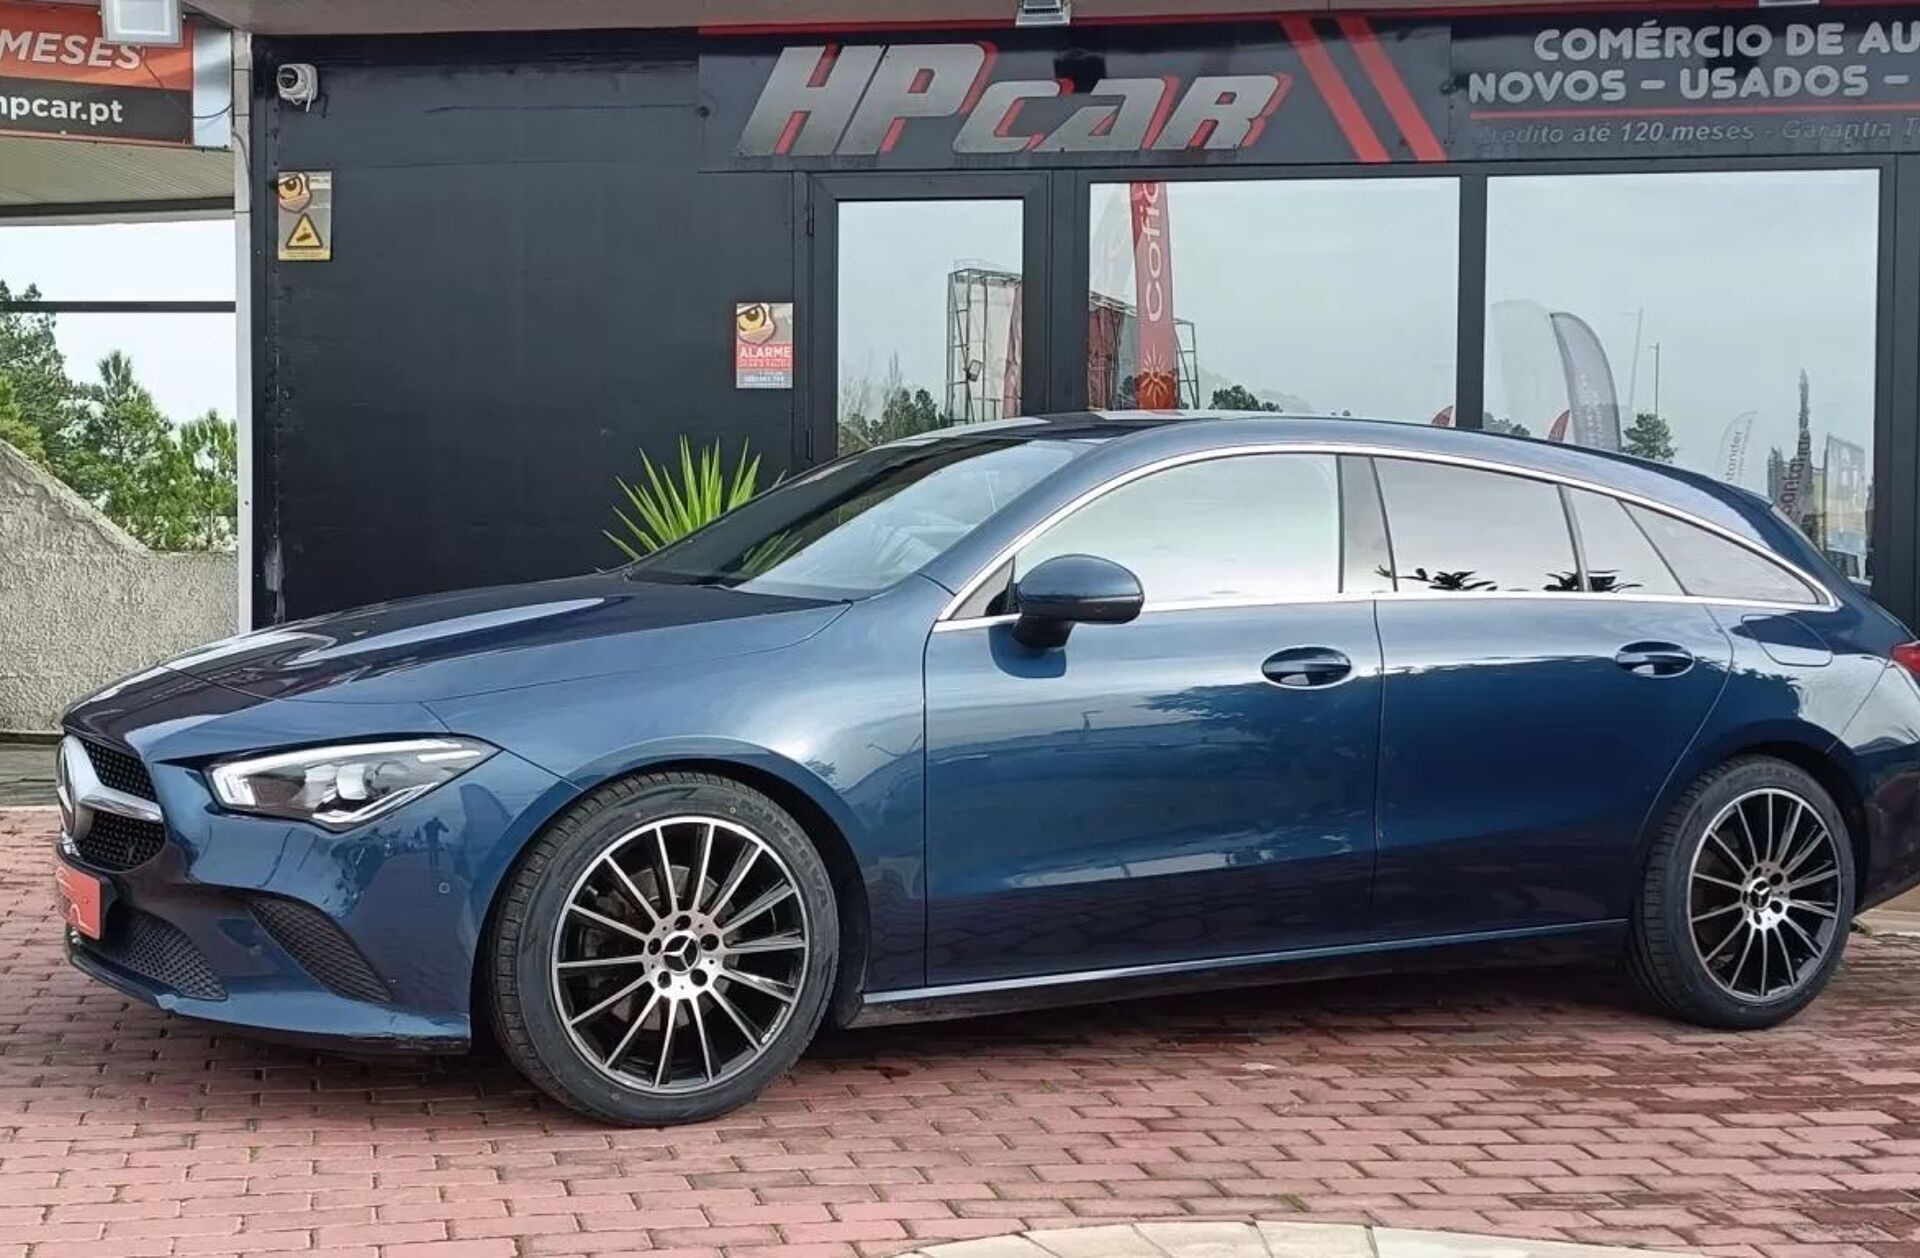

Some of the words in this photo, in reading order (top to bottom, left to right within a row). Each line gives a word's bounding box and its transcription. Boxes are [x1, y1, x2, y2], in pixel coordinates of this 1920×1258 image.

[0, 28, 140, 70] MESES
[1534, 20, 1773, 61] COMÉRCIO
[1786, 23, 1845, 55] DE
[1857, 21, 1920, 54] AU
[1468, 70, 1626, 103] NOVOS
[1680, 65, 1868, 99] USADOS
[1620, 121, 1664, 142] 120
[1671, 123, 1754, 141] meses
[740, 345, 791, 358] ALARME
